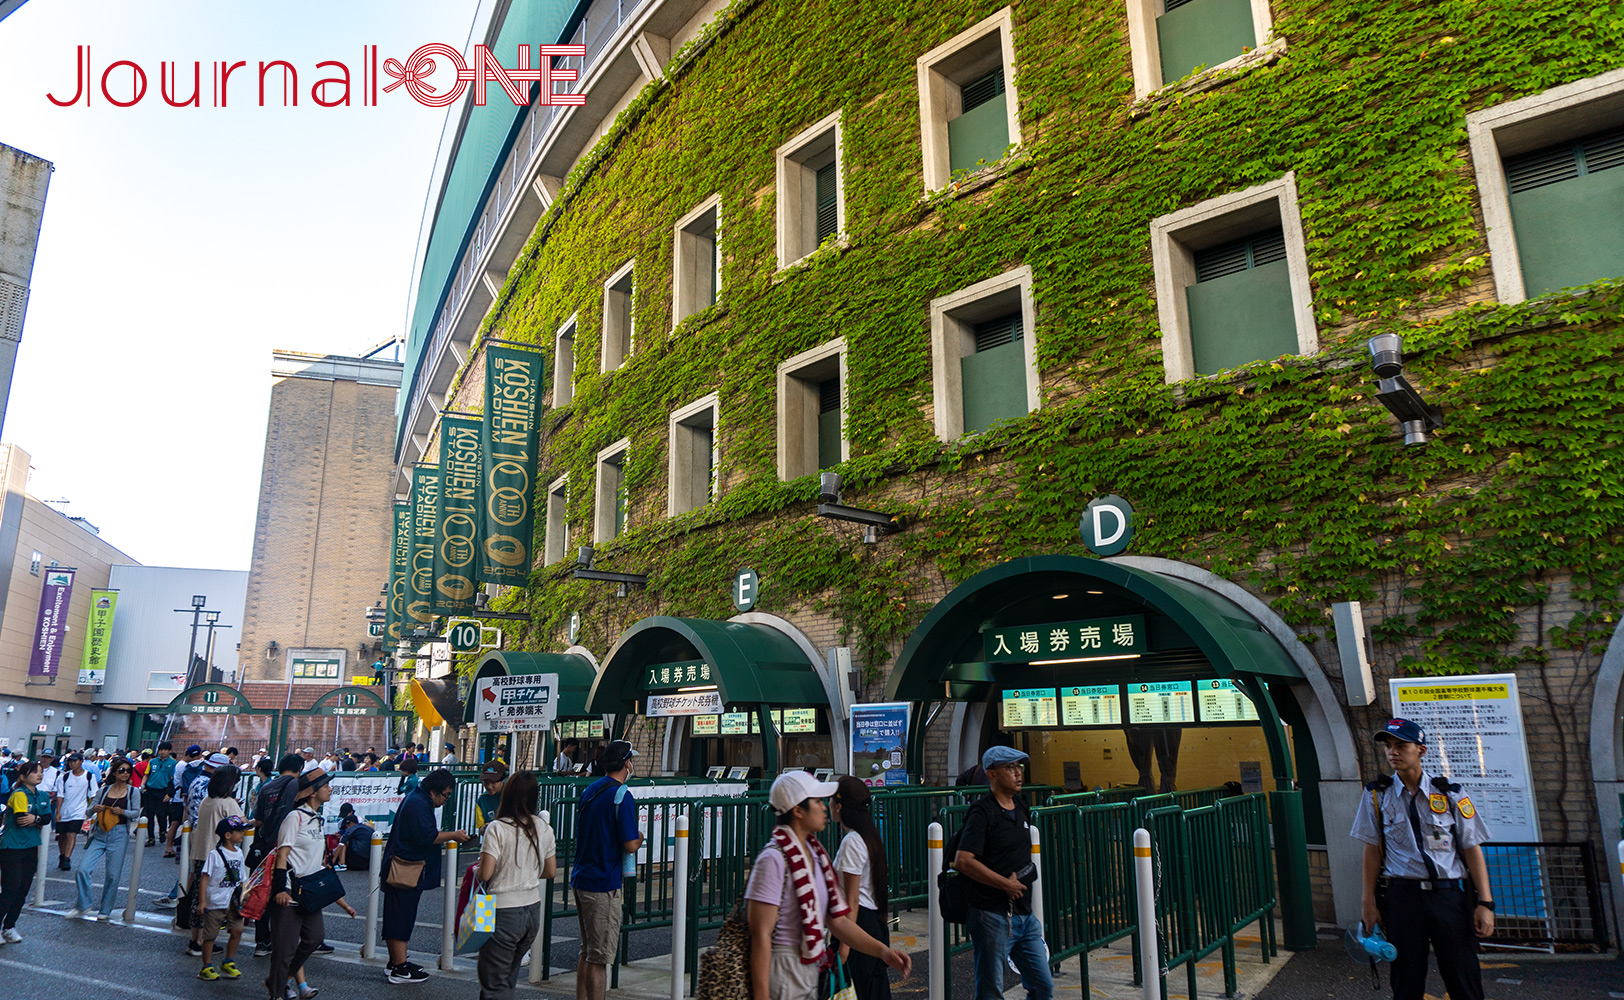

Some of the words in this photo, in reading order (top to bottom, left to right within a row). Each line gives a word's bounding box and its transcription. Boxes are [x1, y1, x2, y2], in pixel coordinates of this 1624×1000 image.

[491, 357, 504, 443] STADIUM
[501, 359, 530, 446] KOSHIEN
[444, 426, 457, 498] STADIUM
[452, 427, 479, 500] KOSHIEN
[415, 475, 426, 536] STADIUM
[1093, 504, 1126, 547] D
[482, 565, 526, 577] 2024
[739, 572, 751, 605] E
[51, 587, 65, 626] Excitement
[39, 617, 51, 650] KOSHIEN
[89, 610, 107, 665] 甲子園歴史館
[456, 626, 476, 647] 10
[570, 615, 577, 639] F
[993, 623, 1134, 656] 入場券売場
[43, 635, 56, 673] Enjoyment
[492, 675, 541, 686] 高校野球専用
[649, 663, 710, 685] 入場券売場
[206, 692, 217, 703] 11
[206, 705, 228, 713] 指定席
[346, 707, 367, 715] 指定席
[347, 694, 356, 704] 11
[502, 687, 535, 704] 甲チケ
[506, 705, 543, 717] 発券端末
